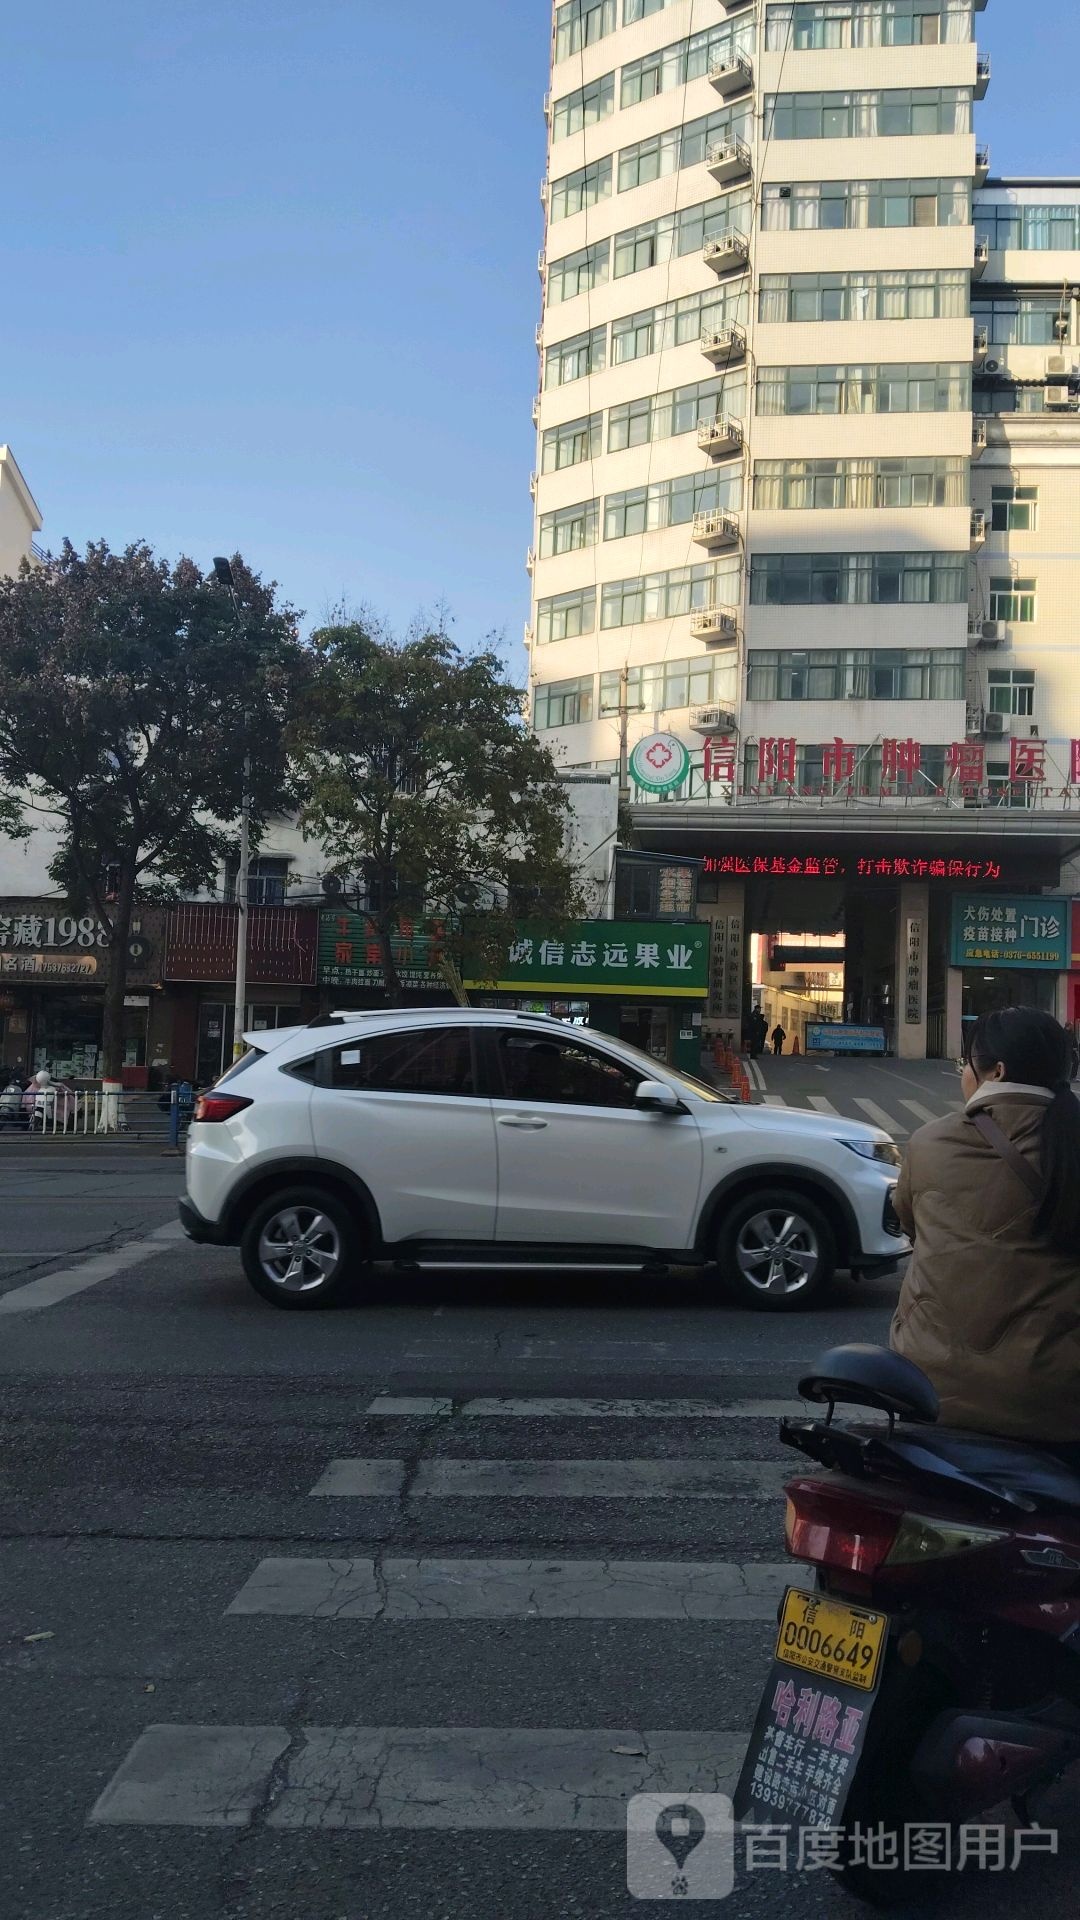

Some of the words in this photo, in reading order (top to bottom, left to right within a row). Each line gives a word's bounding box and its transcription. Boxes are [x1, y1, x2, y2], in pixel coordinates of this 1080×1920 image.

[721, 785, 830, 797] XINYANG
[963, 905, 1017, 922] 犬伤处置
[1020, 915, 1060, 938] 门诊
[963, 926, 1017, 942] 疫苗接种
[0, 956, 37, 973] 名酒
[508, 939, 693, 970] 诚信志远果业
[907, 922, 921, 1019] 信阳市肿瘤医院
[803, 1602, 818, 1625] 信
[849, 1620, 866, 1640] 阳
[783, 1621, 873, 1670] 0006649
[771, 1679, 864, 1755] 哈利路亚
[758, 1746, 804, 1777] 出售二手车
[805, 1764, 842, 1796] 手续齐全
